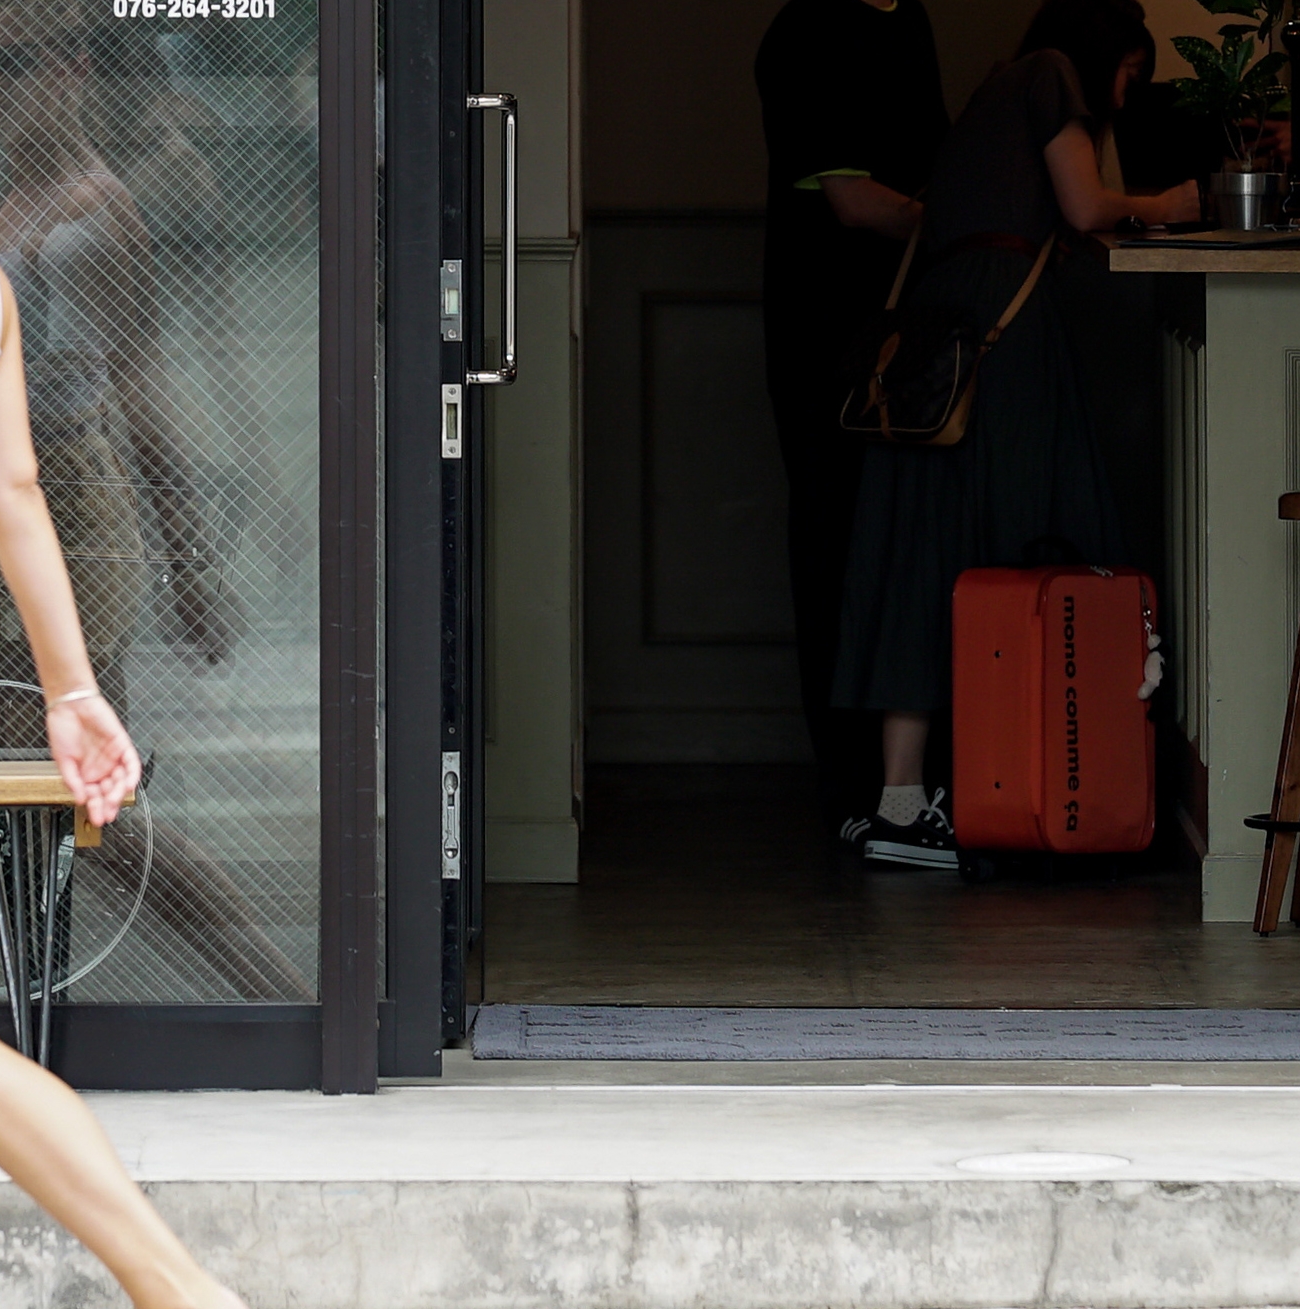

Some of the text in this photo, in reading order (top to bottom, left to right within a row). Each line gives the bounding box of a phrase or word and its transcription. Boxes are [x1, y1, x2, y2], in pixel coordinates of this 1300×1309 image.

[1063, 596, 1079, 832] mono comme ça
